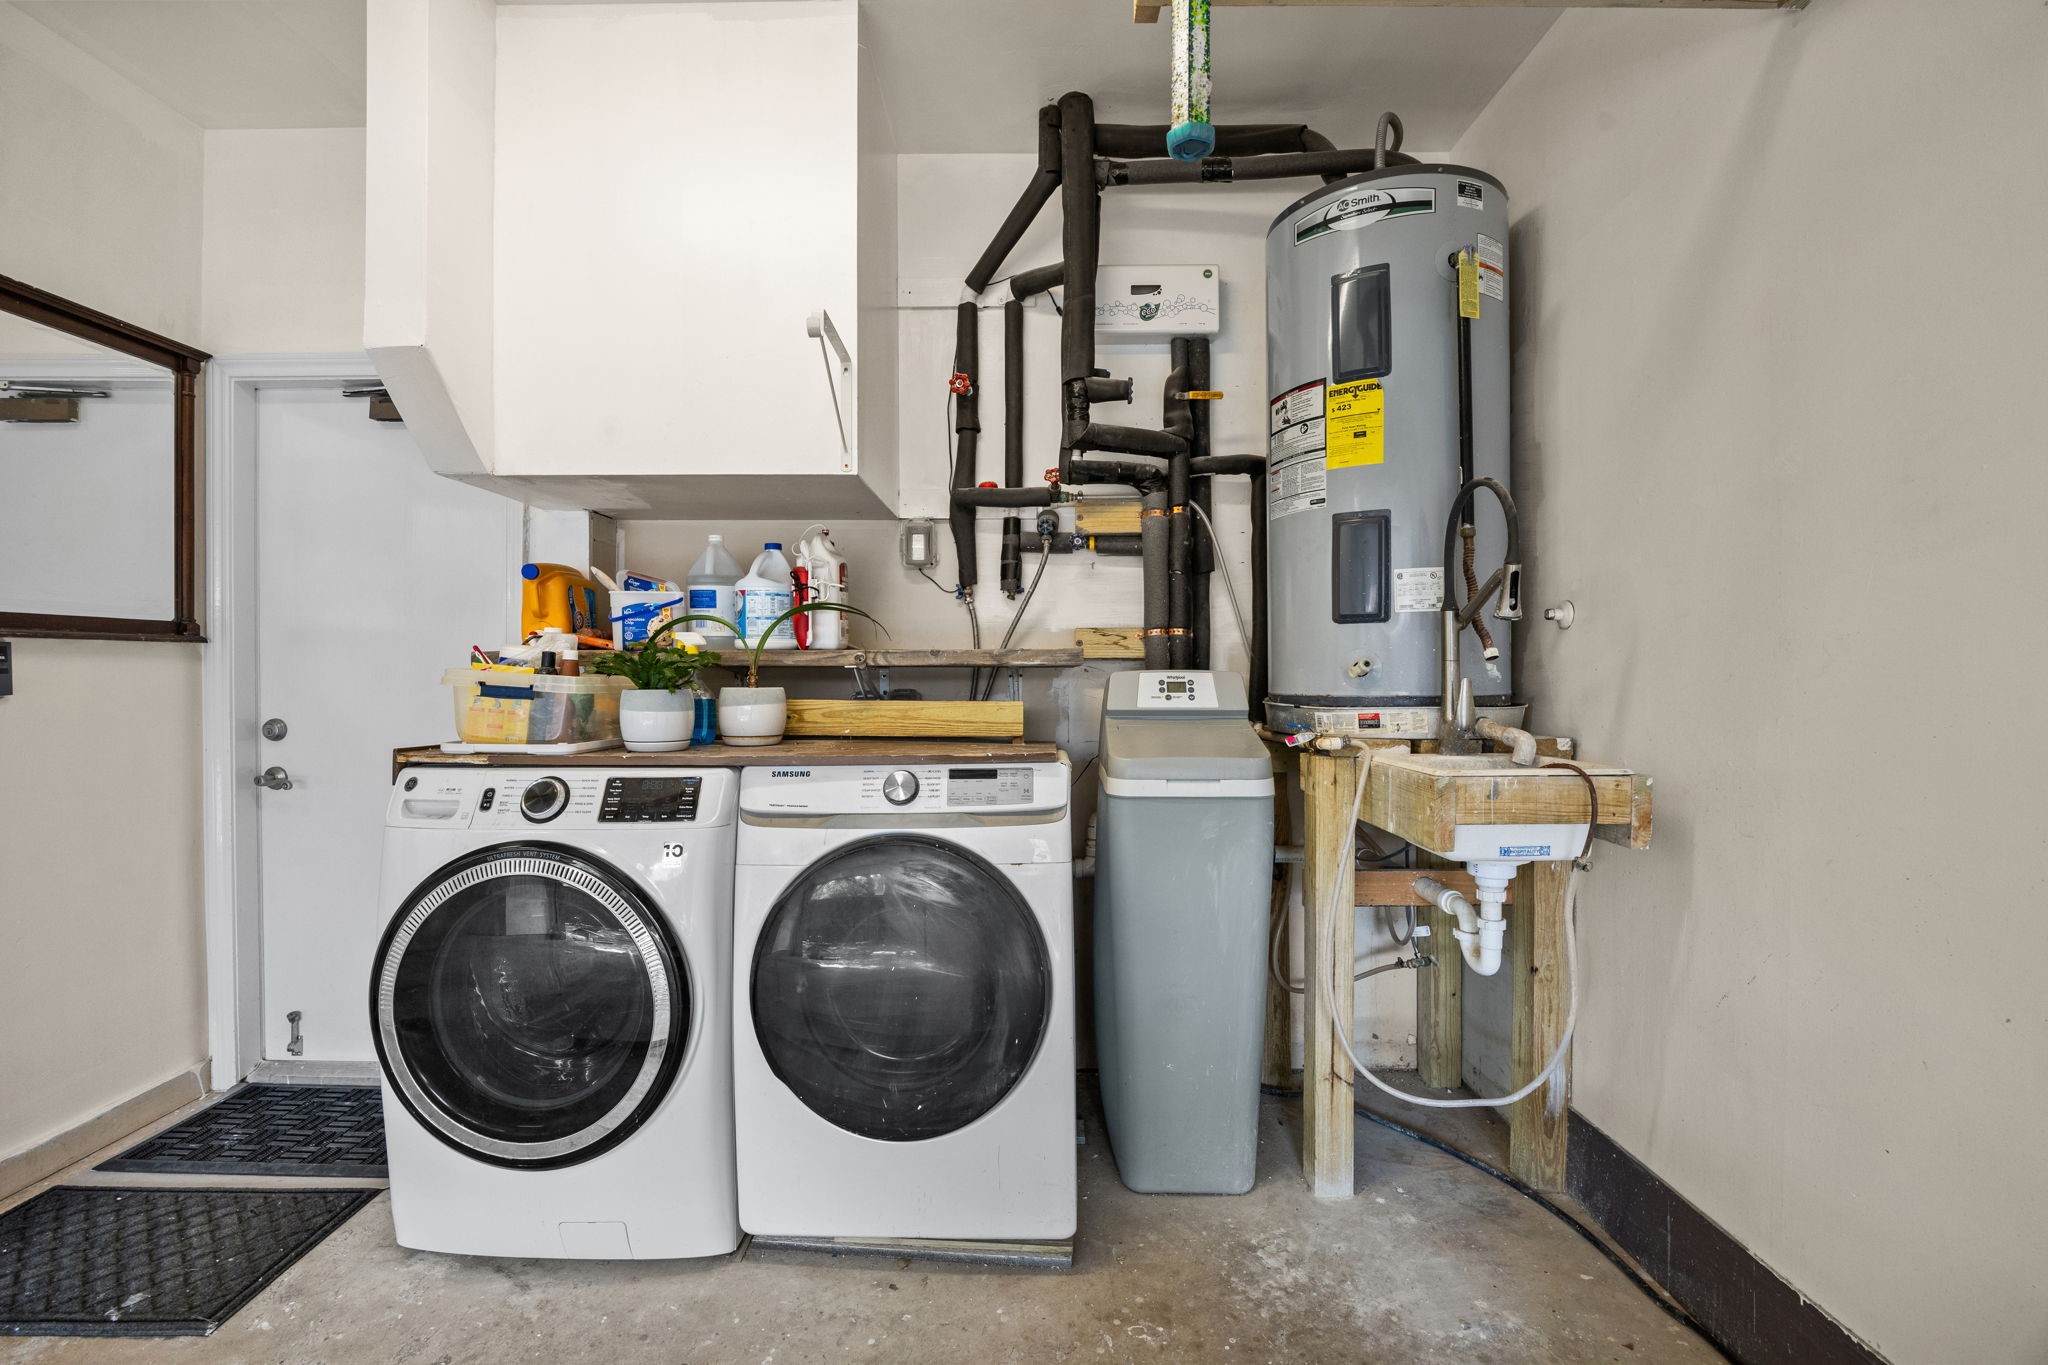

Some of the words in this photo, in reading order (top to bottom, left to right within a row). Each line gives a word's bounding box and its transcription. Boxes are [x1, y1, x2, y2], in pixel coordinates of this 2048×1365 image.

[1351, 194, 1379, 207] Smith
[1141, 307, 1157, 316] eco
[1336, 403, 1352, 411] 423
[486, 851, 521, 861] ULTRAFRESH
[522, 850, 538, 858] VENT
[539, 852, 561, 861] SYSTEM
